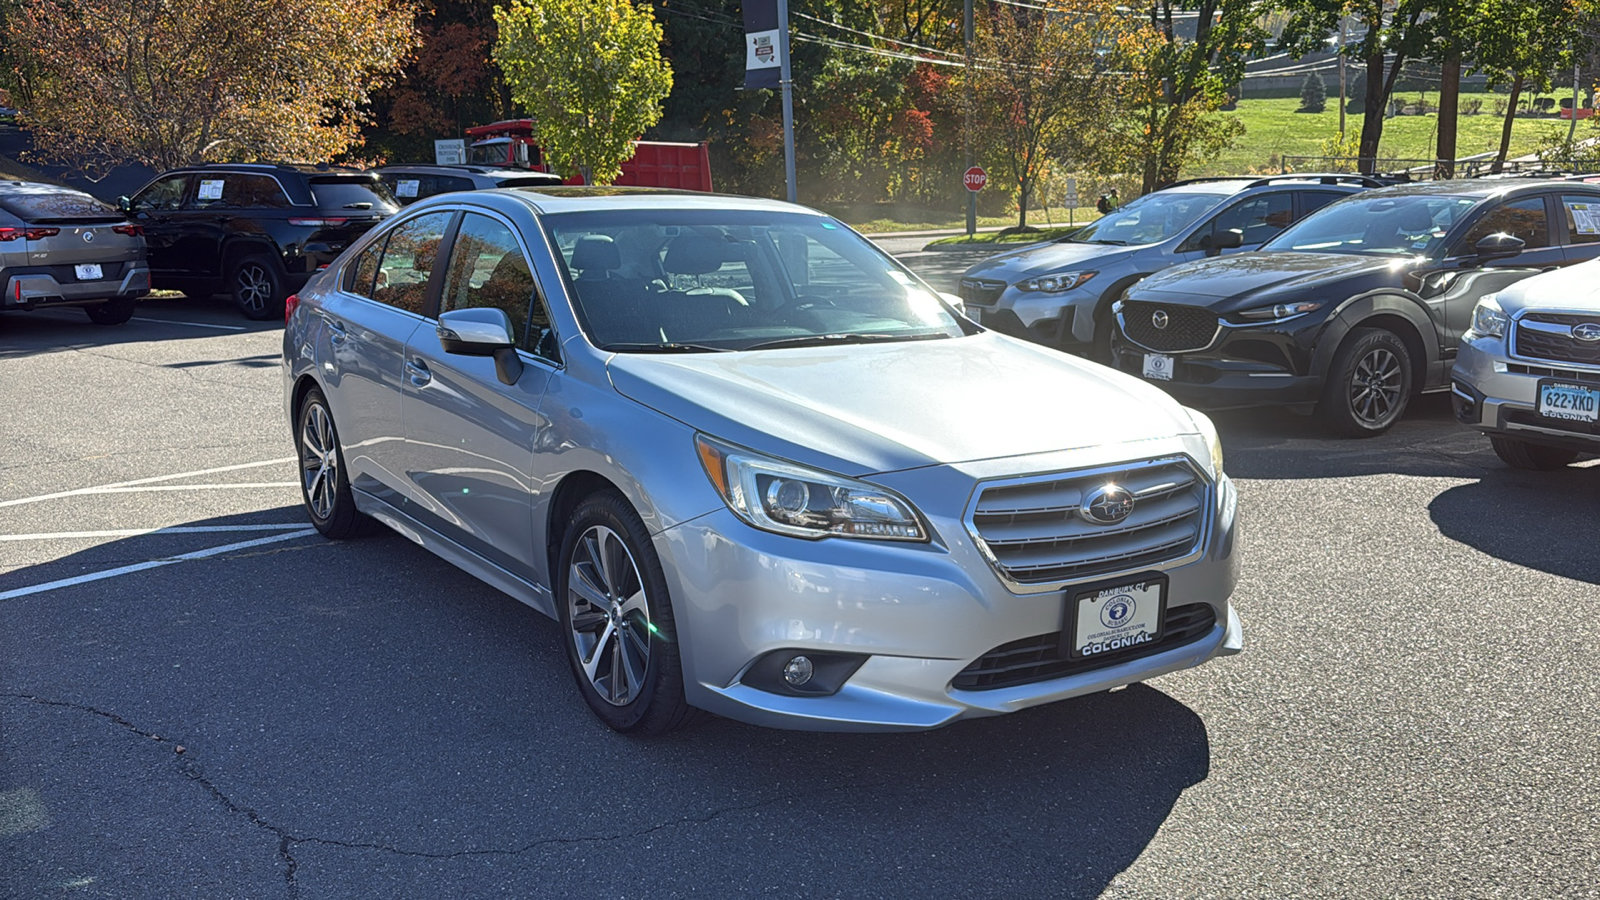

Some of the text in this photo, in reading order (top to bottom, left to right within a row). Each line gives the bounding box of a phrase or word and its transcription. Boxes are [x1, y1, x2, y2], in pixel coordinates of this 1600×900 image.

[965, 174, 986, 184] STOP
[1542, 412, 1593, 422] COLONIAL
[1098, 585, 1134, 597] DANBURY
[1105, 597, 1132, 610] COLONIAL
[1082, 634, 1152, 655] COLONIAL
